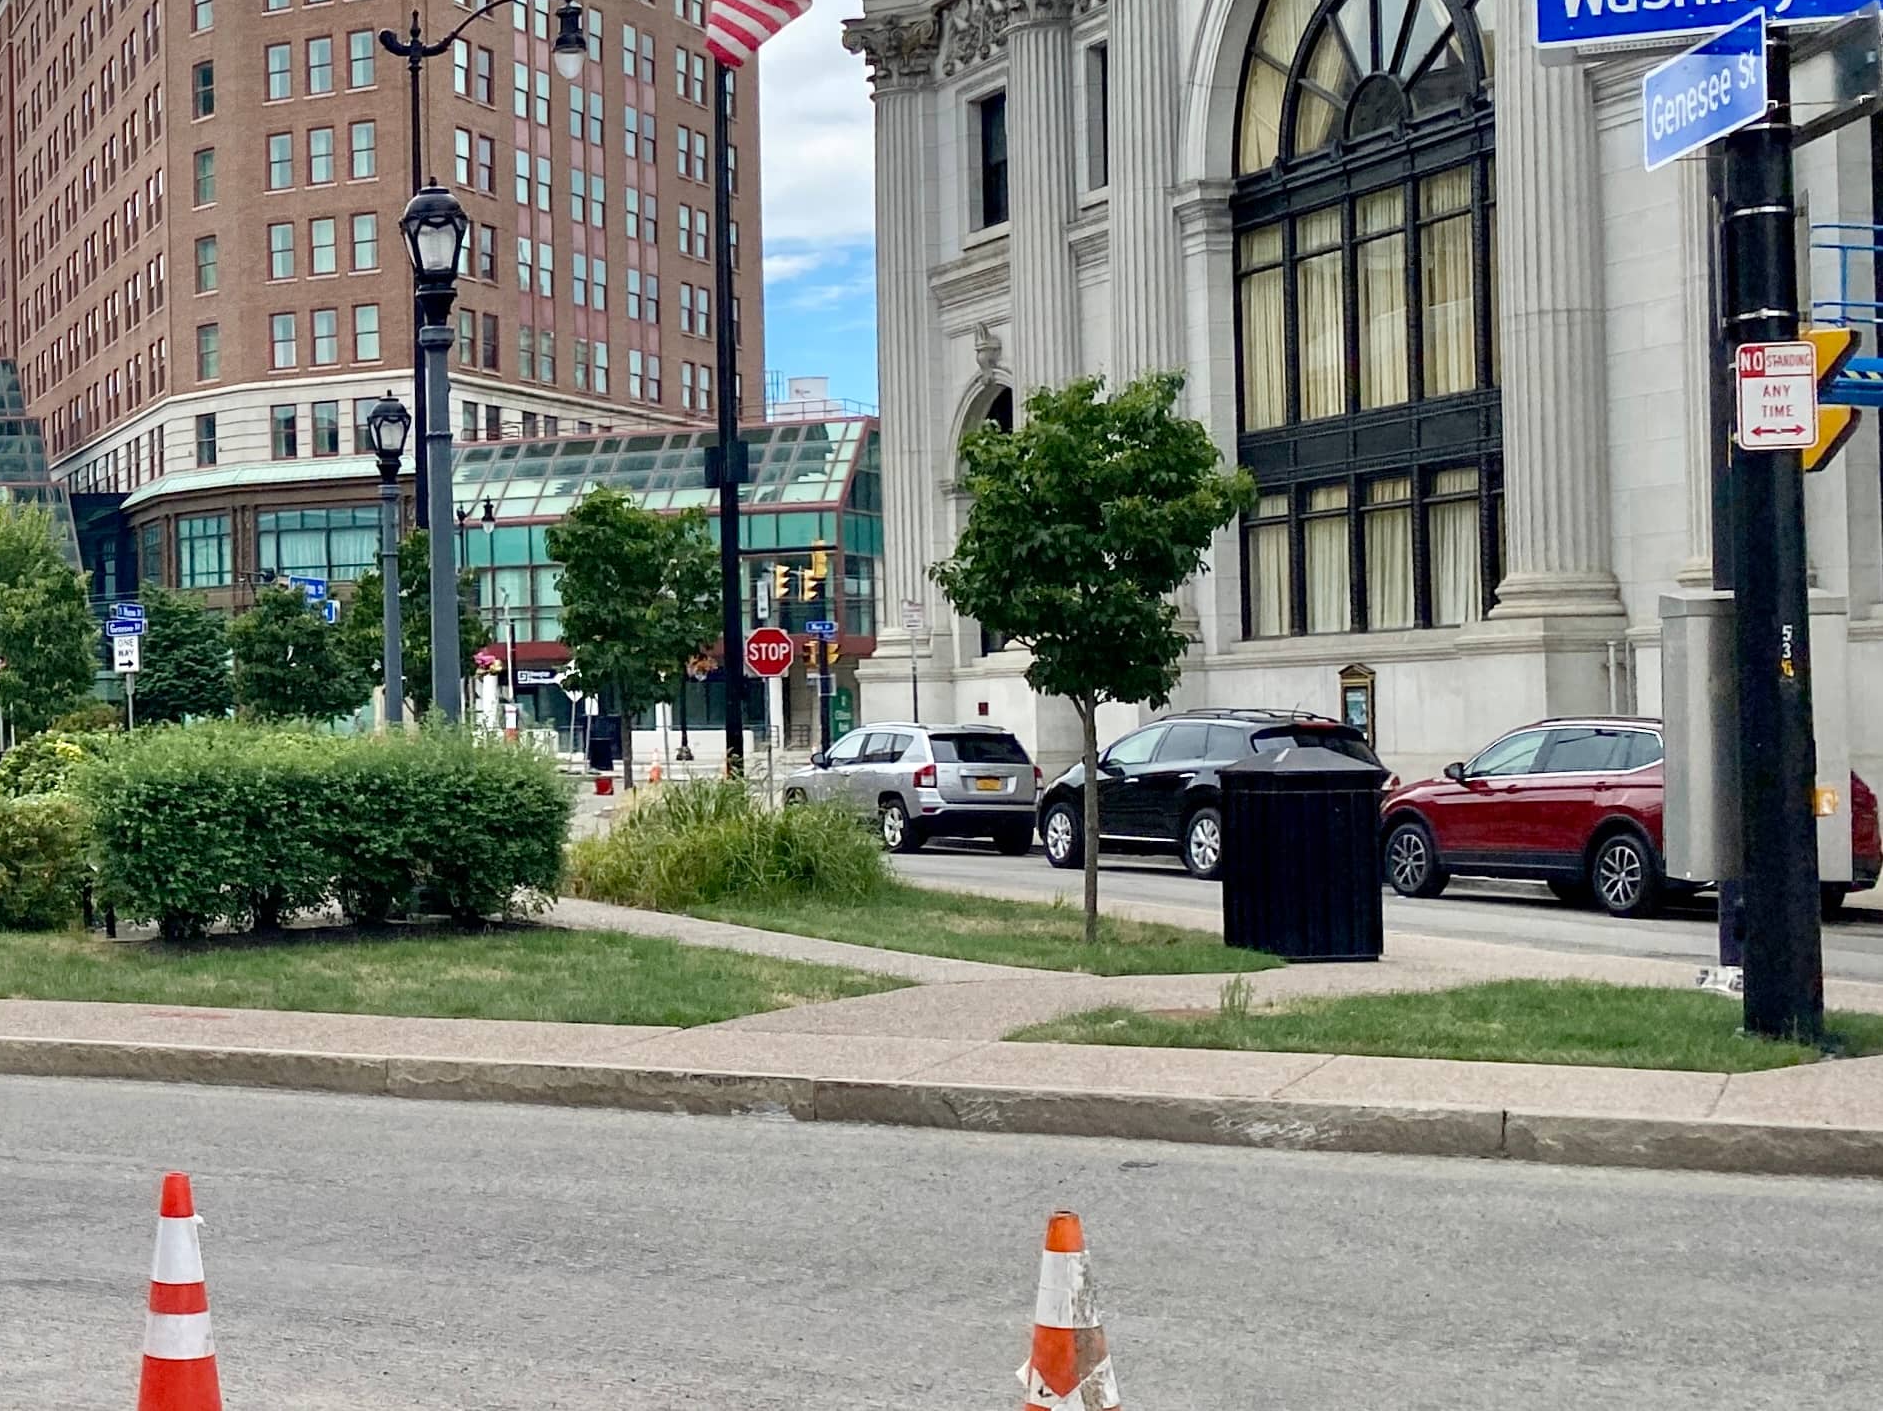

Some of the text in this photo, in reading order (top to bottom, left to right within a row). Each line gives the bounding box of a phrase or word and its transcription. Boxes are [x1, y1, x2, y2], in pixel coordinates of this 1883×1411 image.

[1651, 48, 1757, 142] Genesee St
[1740, 351, 1811, 372] NO STANDING
[1763, 385, 1790, 397] ANY
[1762, 404, 1794, 417] TIME
[118, 638, 134, 647] ONE
[748, 643, 790, 661] STOP
